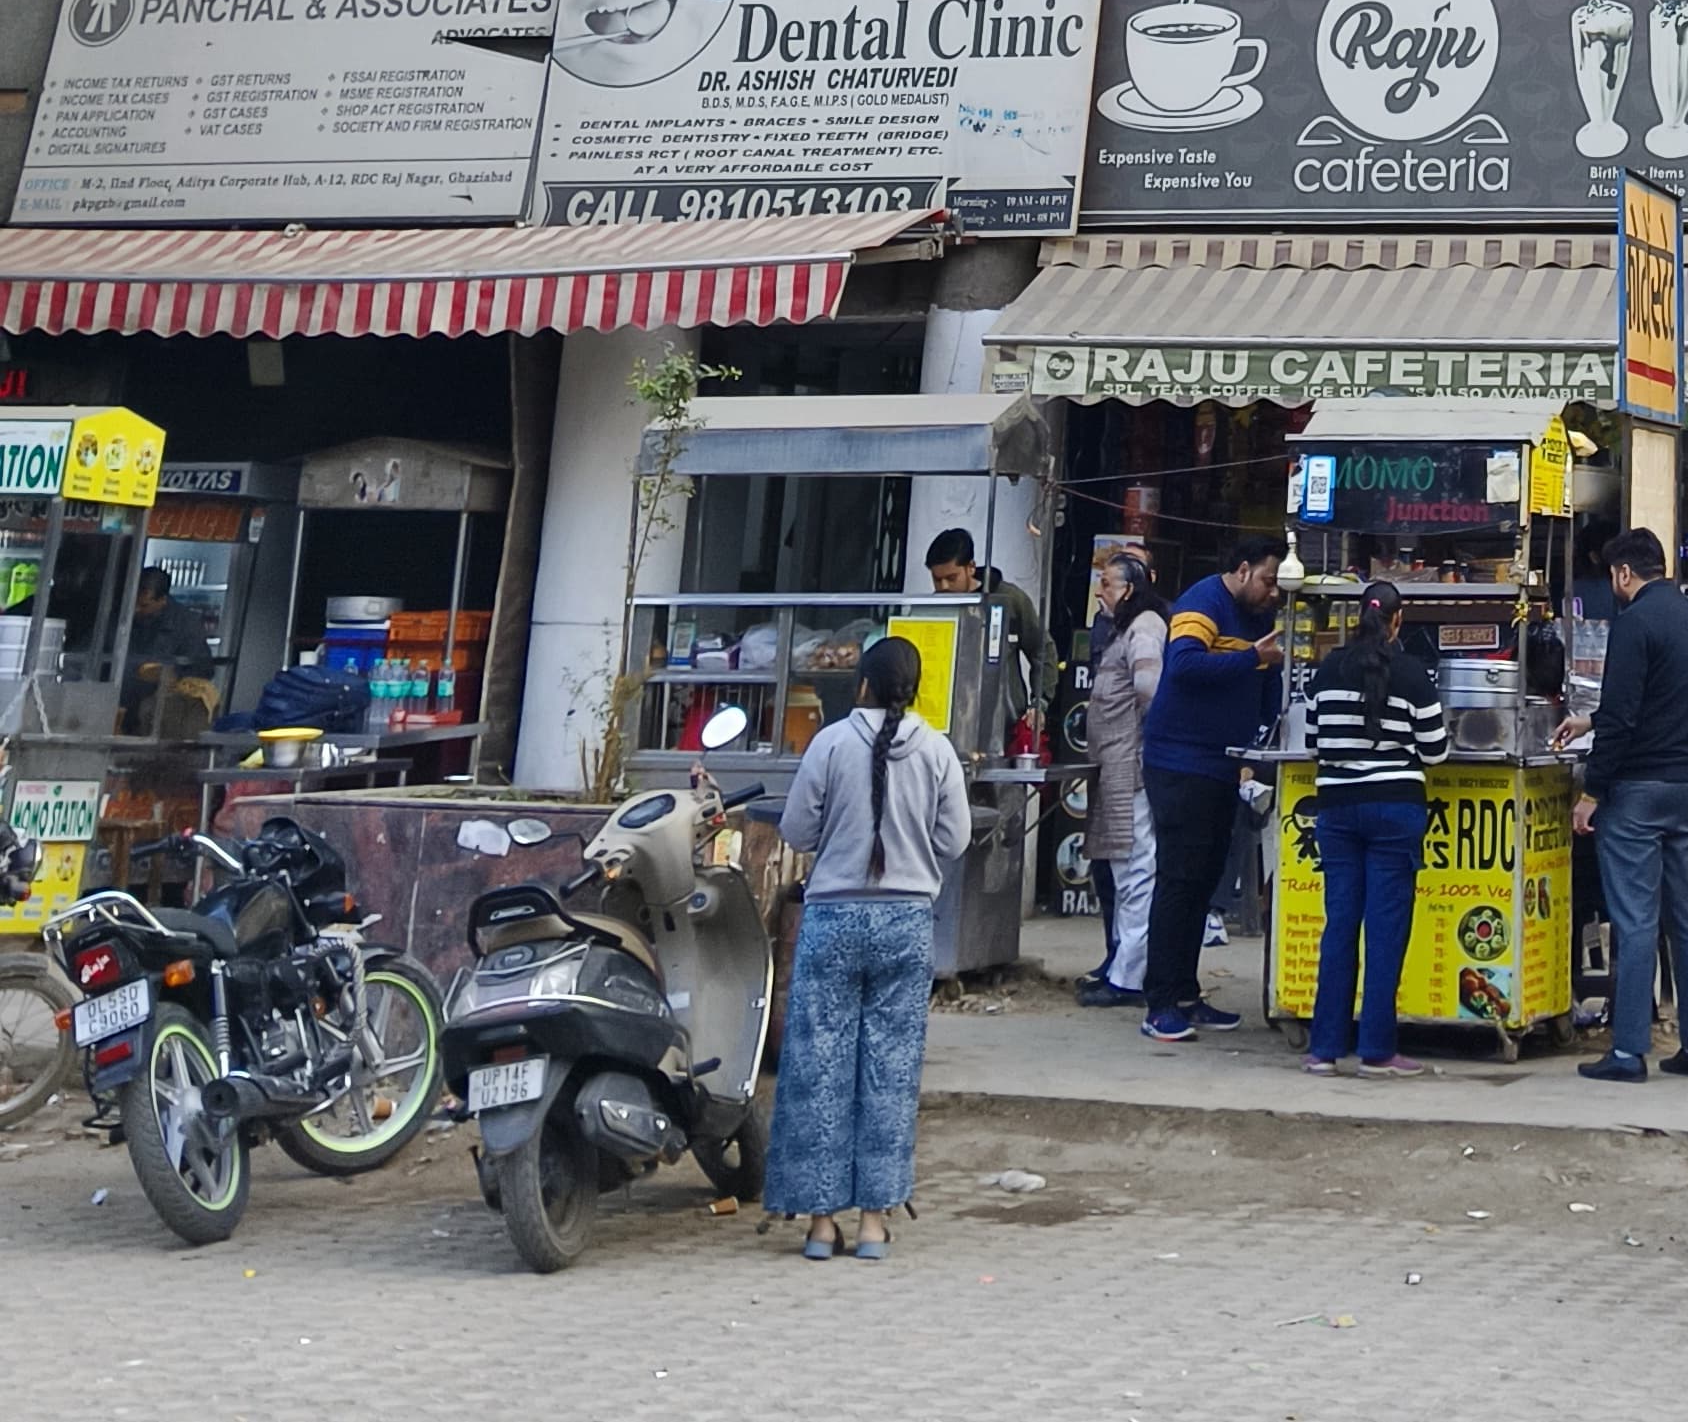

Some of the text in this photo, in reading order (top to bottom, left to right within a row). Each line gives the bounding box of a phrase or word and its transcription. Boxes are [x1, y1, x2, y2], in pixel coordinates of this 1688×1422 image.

[733, 0, 907, 63] Dental
[1328, 0, 1487, 114] Raju
[211, 73, 291, 86] GST RETURNS
[698, 65, 958, 93] DR. ASHISH CHATURVEDI
[200, 123, 262, 135] VAT CASES
[825, 114, 939, 126] SMILE DESIGN
[763, 131, 869, 142] FIXED TEETH
[1098, 146, 1217, 170] Expensive Taste
[1293, 145, 1510, 196] cafeteria
[1649, 166, 1685, 179] Items
[1143, 171, 1252, 194] Expensive You
[1588, 184, 1618, 198] Also
[566, 189, 664, 225] CALL
[1093, 347, 1611, 387] RAJU CAFETERIA
[1103, 384, 1142, 395] SPL.
[1148, 384, 1183, 396] TEA
[1209, 386, 1281, 397] COFFEE
[159, 470, 233, 491] VOLTAS
[1386, 497, 1489, 523] Junction
[1456, 798, 1516, 871] RDC
[1439, 883, 1512, 901] 100% Veg
